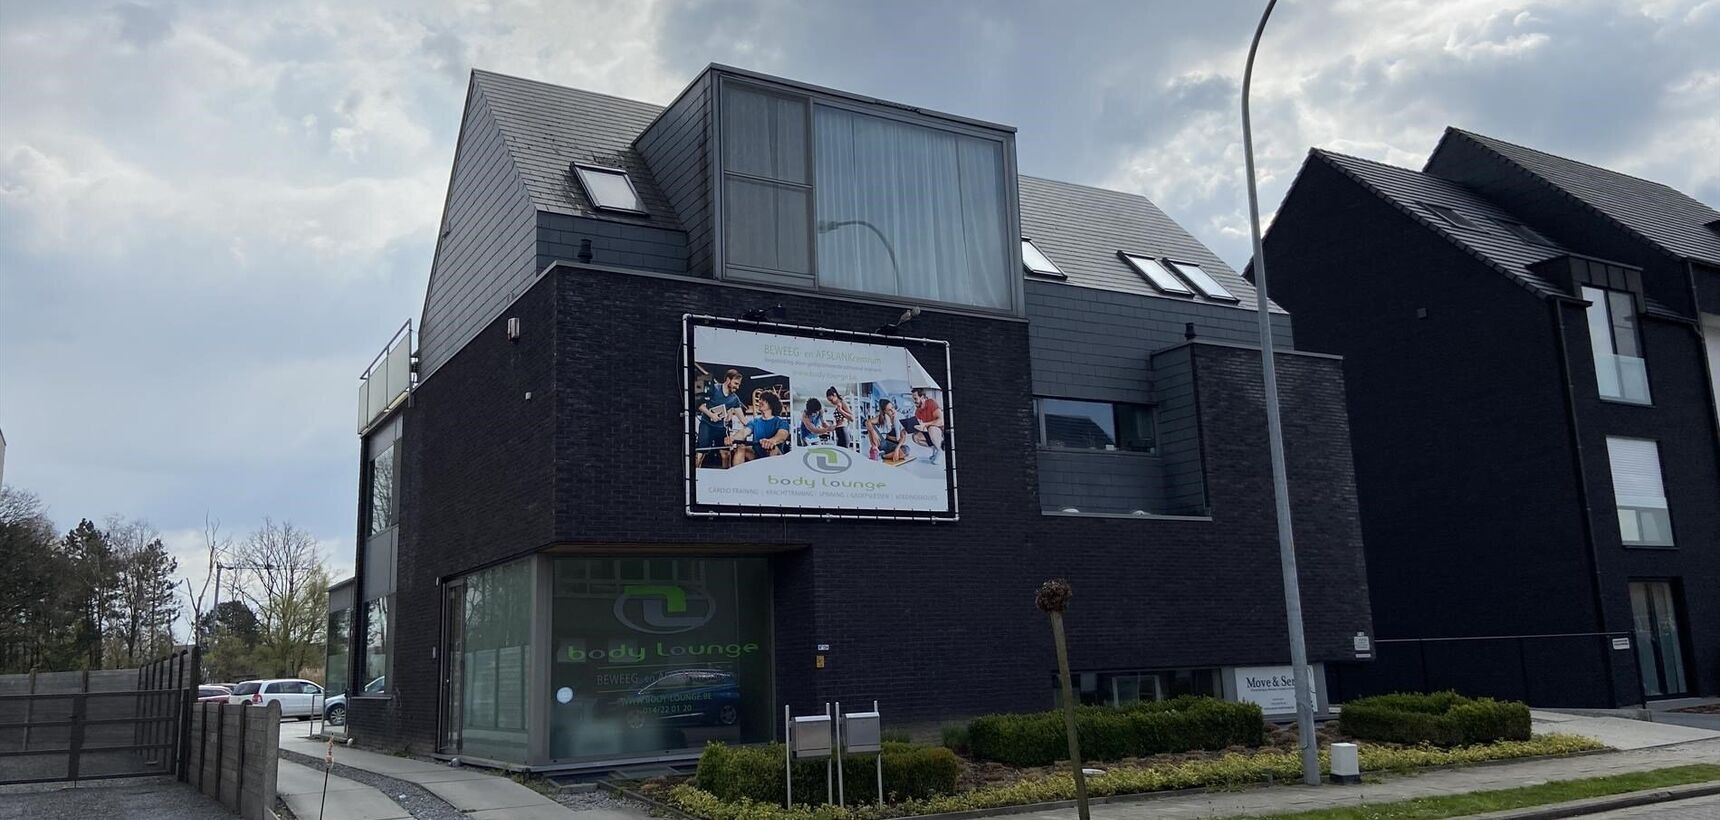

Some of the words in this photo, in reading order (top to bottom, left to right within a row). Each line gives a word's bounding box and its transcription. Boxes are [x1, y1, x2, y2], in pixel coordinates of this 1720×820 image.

[767, 475, 815, 489] body
[822, 477, 887, 492] lounge
[567, 643, 646, 662] body
[1246, 676, 1271, 688] Move
[1272, 675, 1280, 687] &
[671, 705, 680, 713] 01
[682, 704, 693, 712] 20
